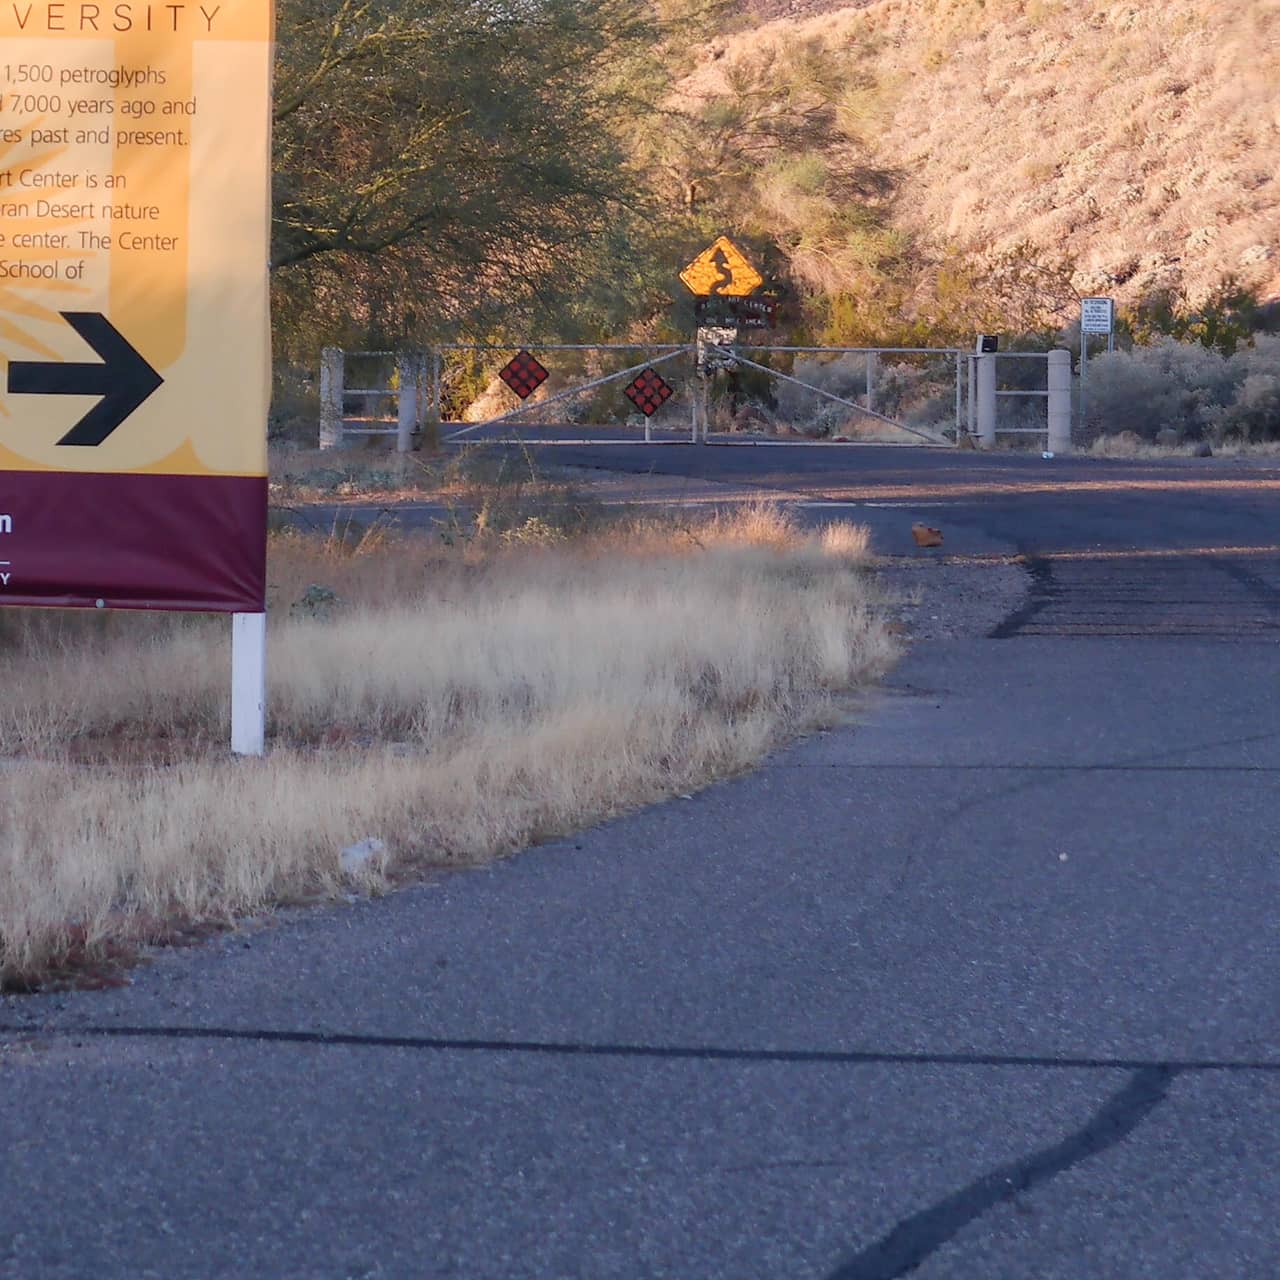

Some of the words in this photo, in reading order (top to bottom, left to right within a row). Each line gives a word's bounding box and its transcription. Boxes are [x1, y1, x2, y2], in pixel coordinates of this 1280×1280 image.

[4, 64, 53, 85] 1,500
[60, 65, 166, 89] petroglyphs
[9, 94, 61, 115] 7,000
[68, 99, 115, 118] years
[120, 100, 156, 119] ago
[162, 96, 196, 115] and
[31, 128, 69, 148] past
[75, 125, 109, 144] and
[117, 128, 188, 149] present.
[19, 166, 79, 191] Center
[86, 169, 98, 188] is
[104, 175, 126, 188] an
[37, 200, 95, 221] Desert
[102, 203, 159, 220] nature
[12, 232, 71, 250] center.
[78, 231, 112, 249] The
[118, 232, 179, 251] Center
[0, 258, 58, 280] School
[65, 260, 84, 279] of
